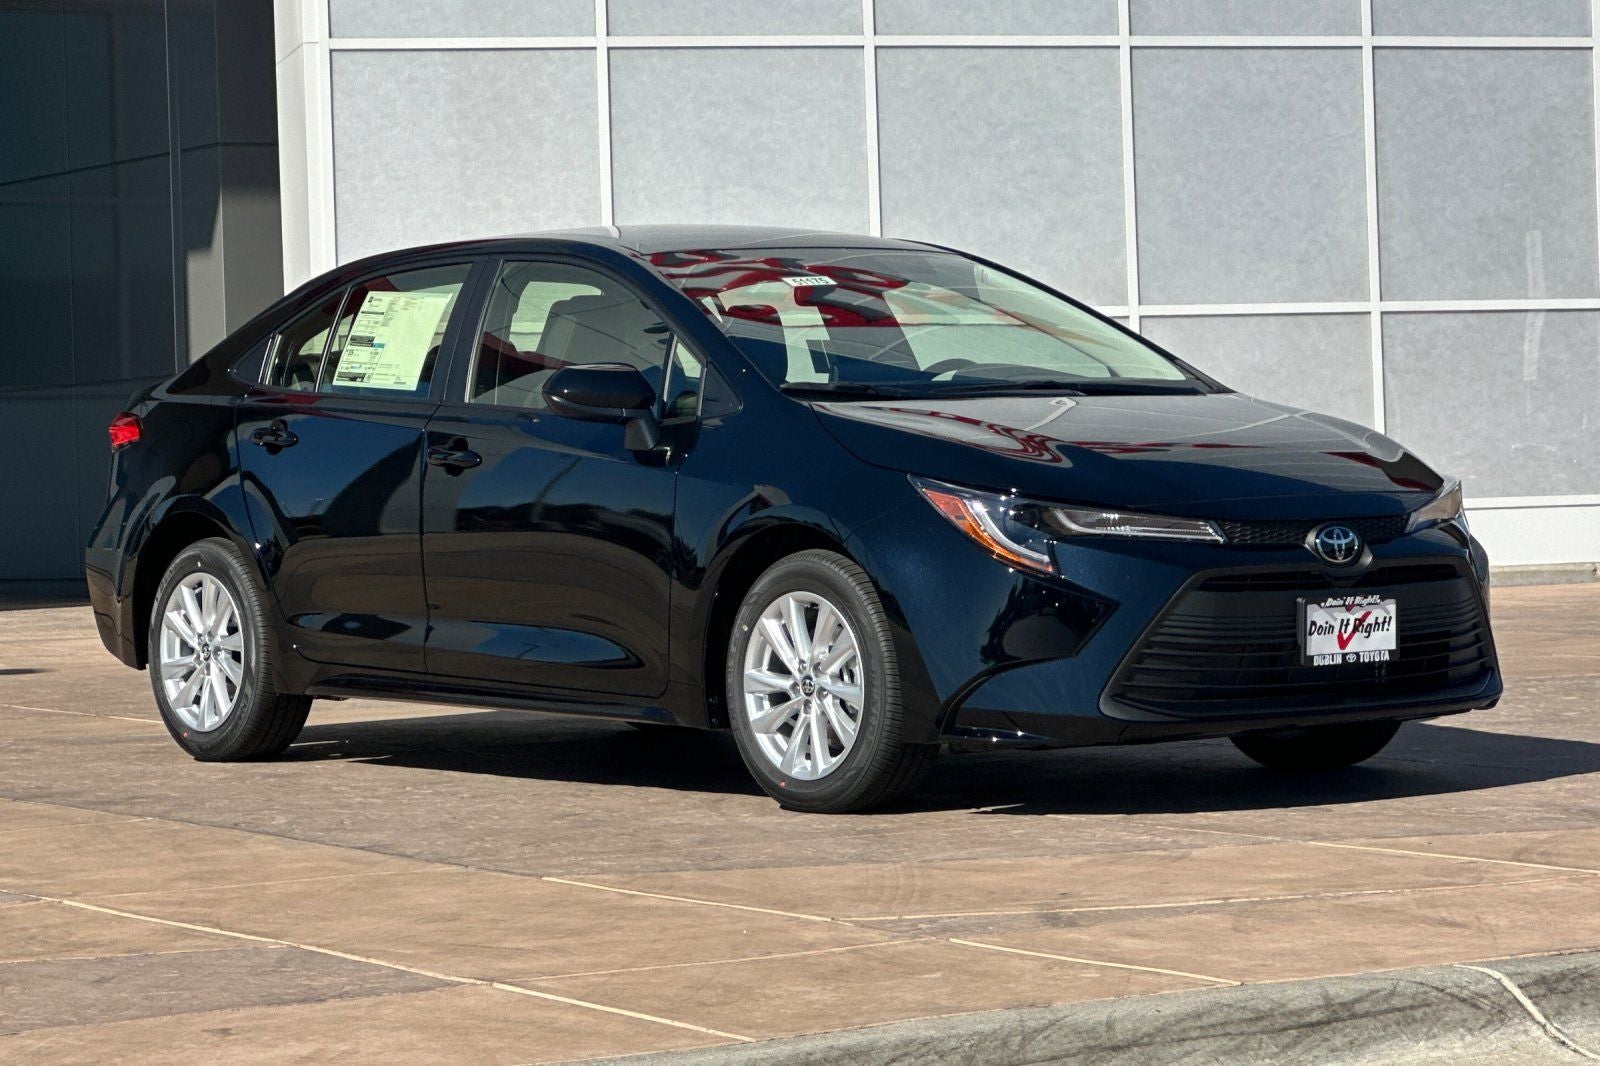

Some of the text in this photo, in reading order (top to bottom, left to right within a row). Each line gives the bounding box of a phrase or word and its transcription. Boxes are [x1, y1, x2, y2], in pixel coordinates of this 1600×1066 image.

[1308, 616, 1392, 638] Doin It Right!
[1313, 650, 1389, 666] DUBLIN TOYOTA
